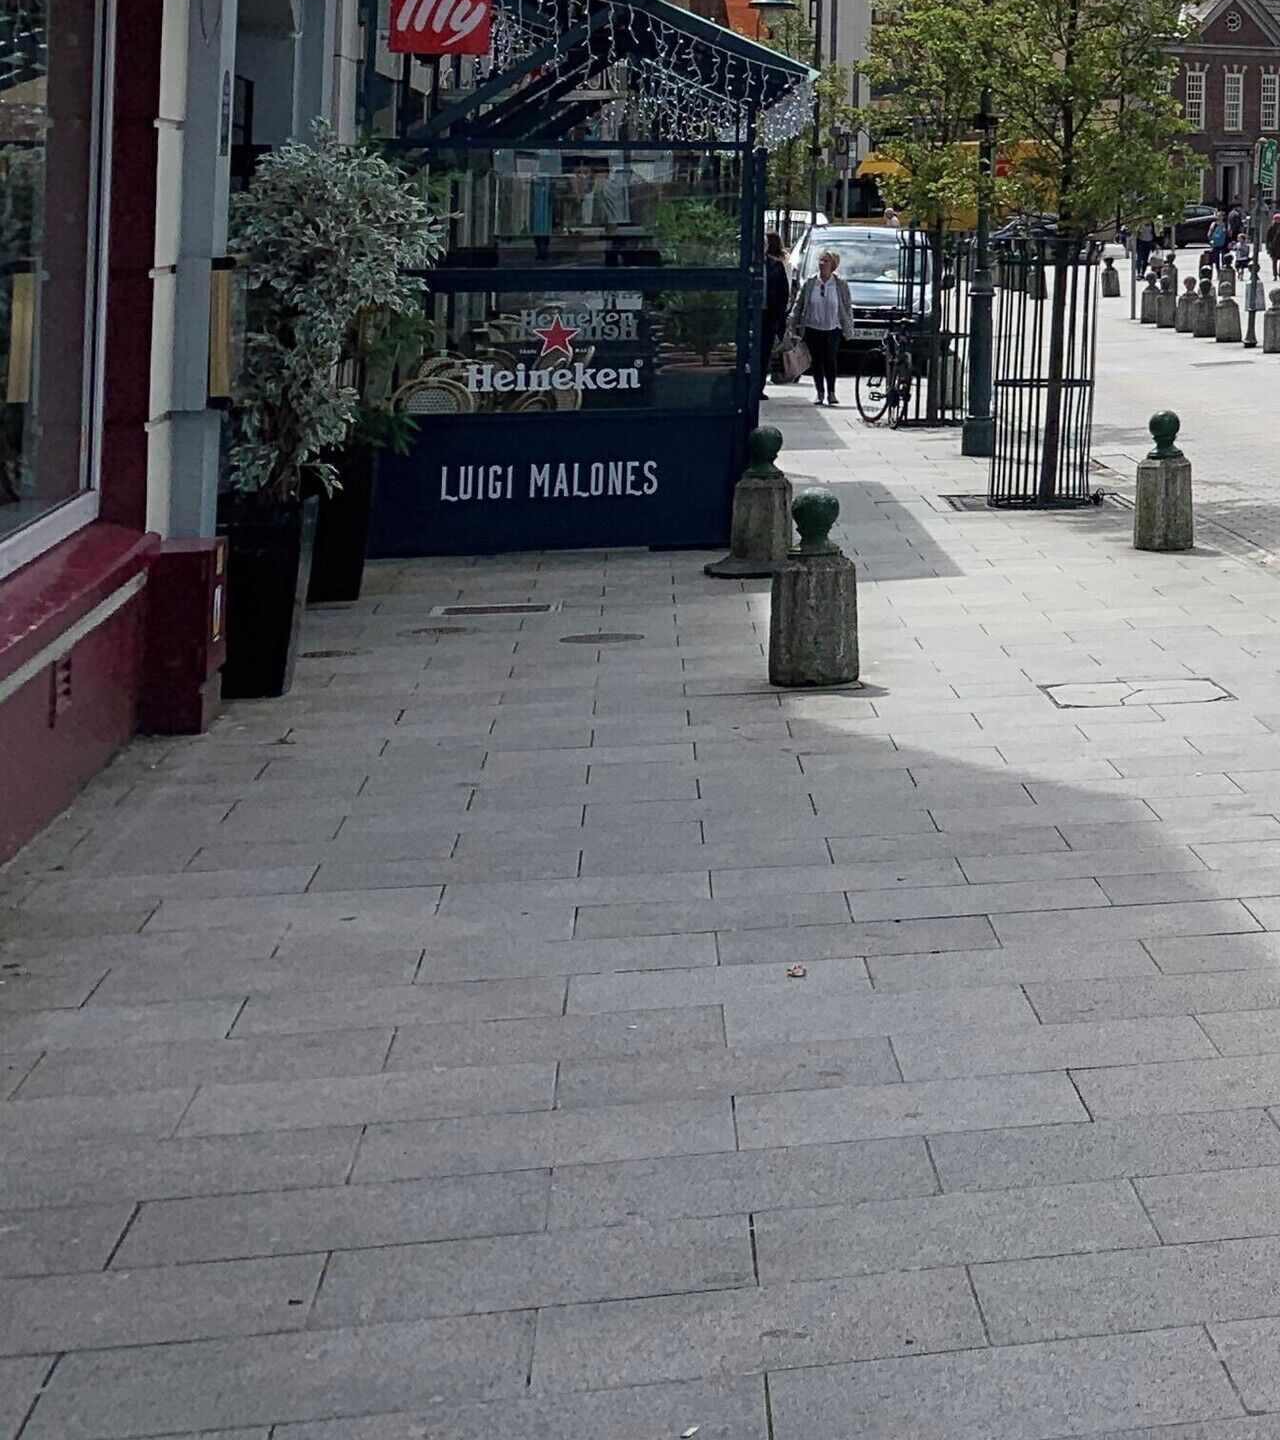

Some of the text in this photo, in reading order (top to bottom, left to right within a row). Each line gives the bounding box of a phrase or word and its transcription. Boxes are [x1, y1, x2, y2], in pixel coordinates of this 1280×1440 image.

[466, 362, 641, 392] Heineken
[440, 461, 658, 502] LUIGI MALONES
